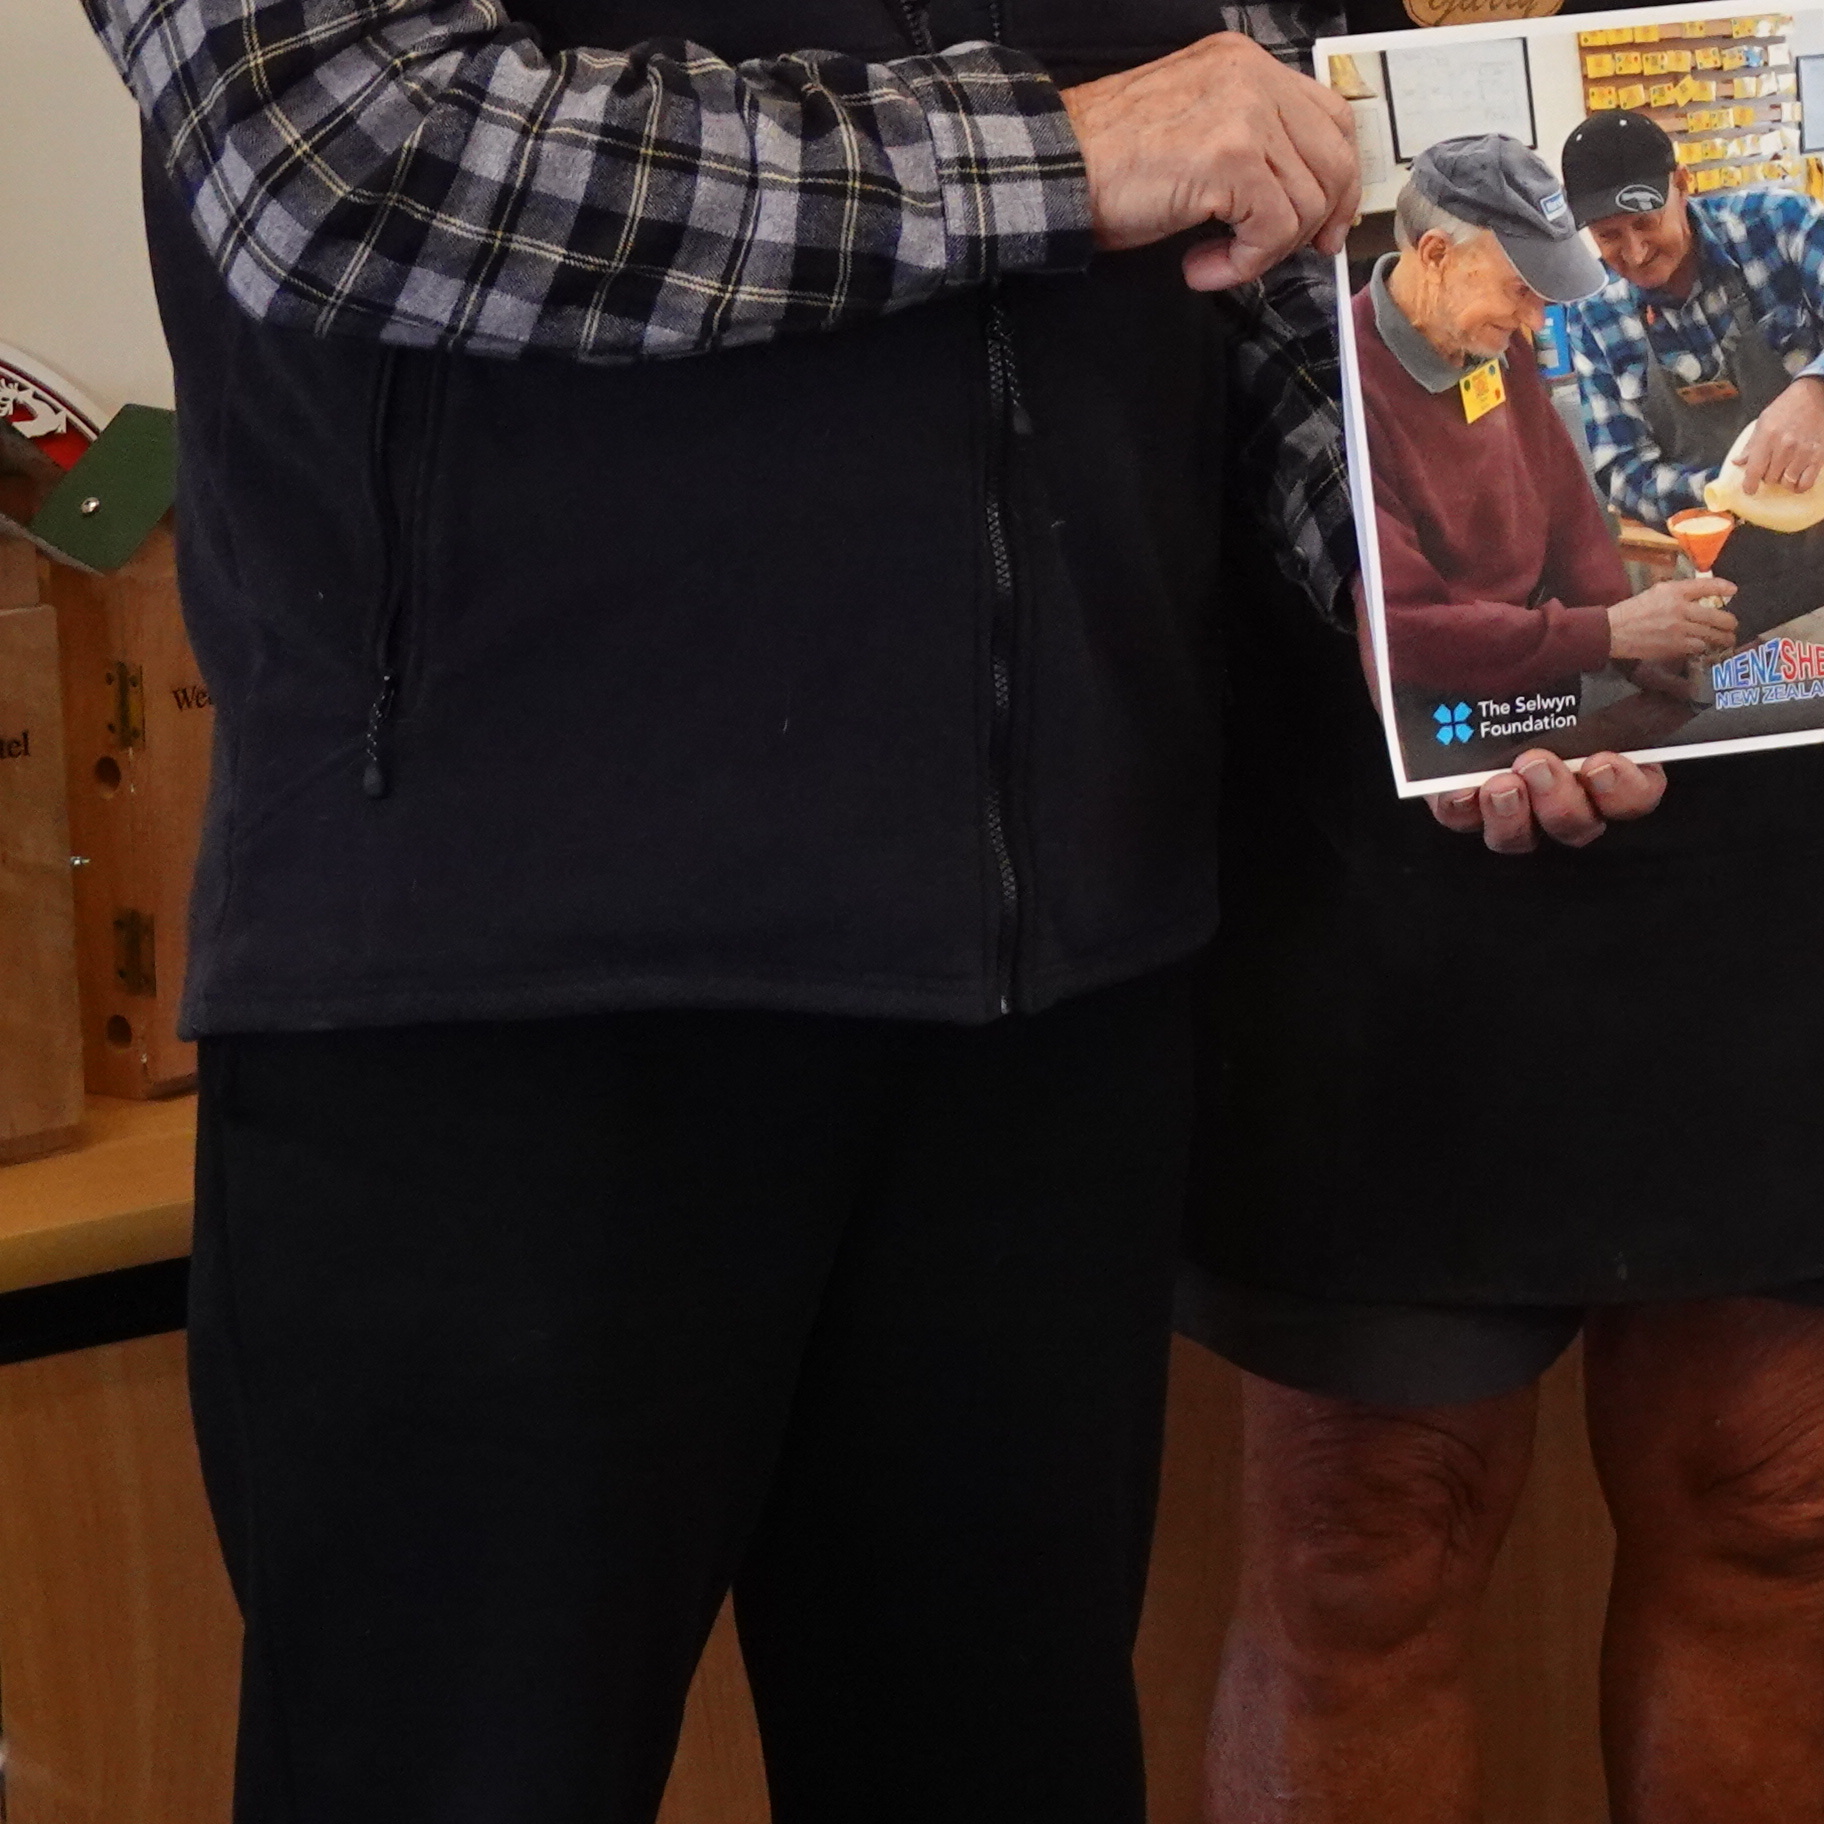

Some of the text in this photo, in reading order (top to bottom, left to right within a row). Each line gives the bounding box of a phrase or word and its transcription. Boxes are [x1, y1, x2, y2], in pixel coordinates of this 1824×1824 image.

[1478, 694, 1576, 717] The Selwyn
[1716, 687, 1760, 710] NEW
[1480, 713, 1577, 738] Foundation
